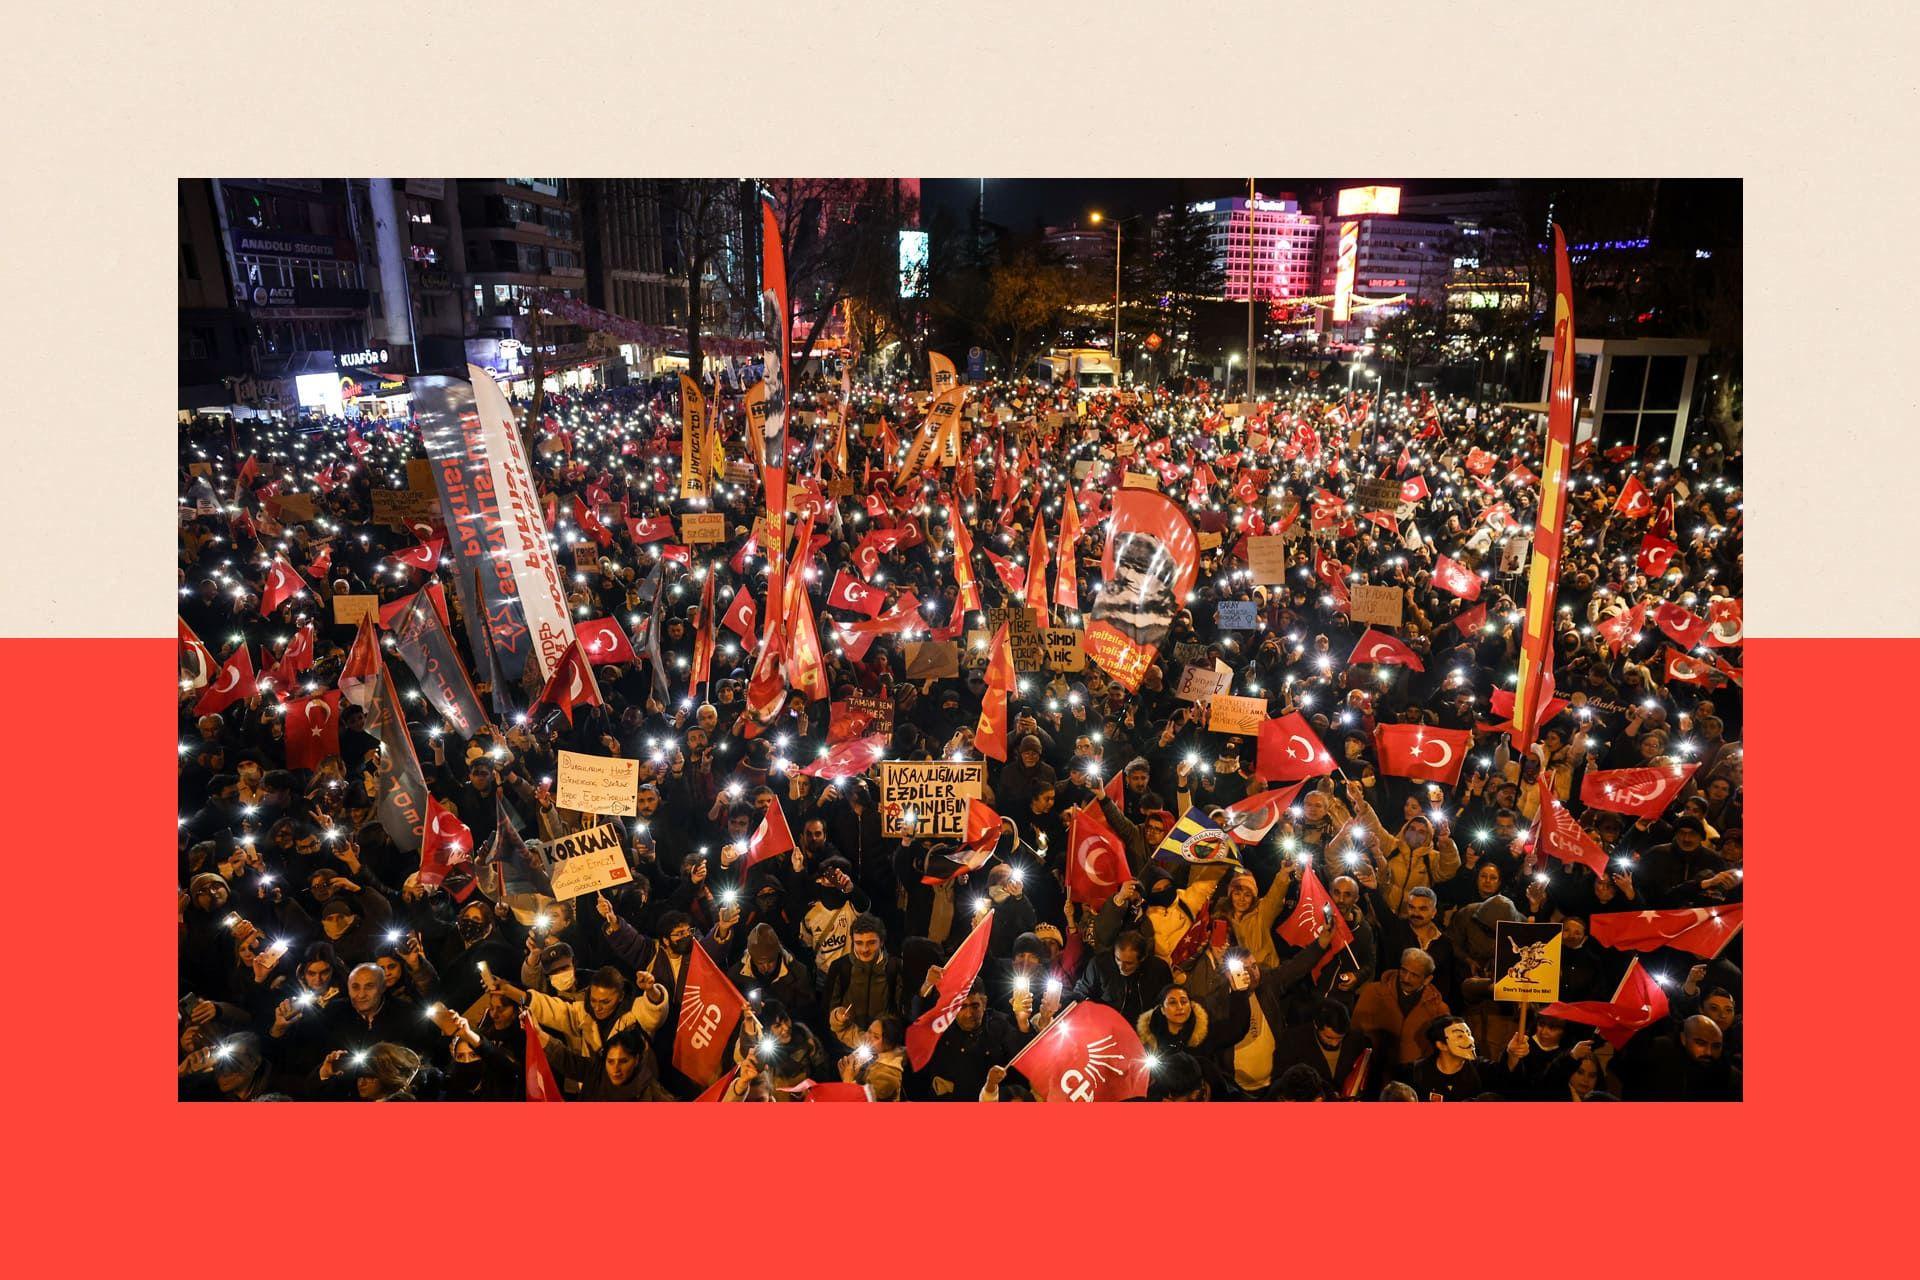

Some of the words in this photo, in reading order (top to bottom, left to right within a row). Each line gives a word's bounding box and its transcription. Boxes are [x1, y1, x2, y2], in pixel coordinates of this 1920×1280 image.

[241, 238, 292, 251] ANADOLU
[341, 350, 378, 366] KUAFÖR
[989, 608, 1009, 621] BEN
[1047, 631, 1076, 648] ŞİMDİ
[1054, 648, 1073, 666] HİÇ
[888, 765, 981, 786] İNSANLIĞIMIZI
[886, 783, 956, 802] EZDİLER
[543, 823, 619, 865] KORKMA!
[1550, 831, 1584, 857] CHP
[690, 1003, 722, 1050] CHP
